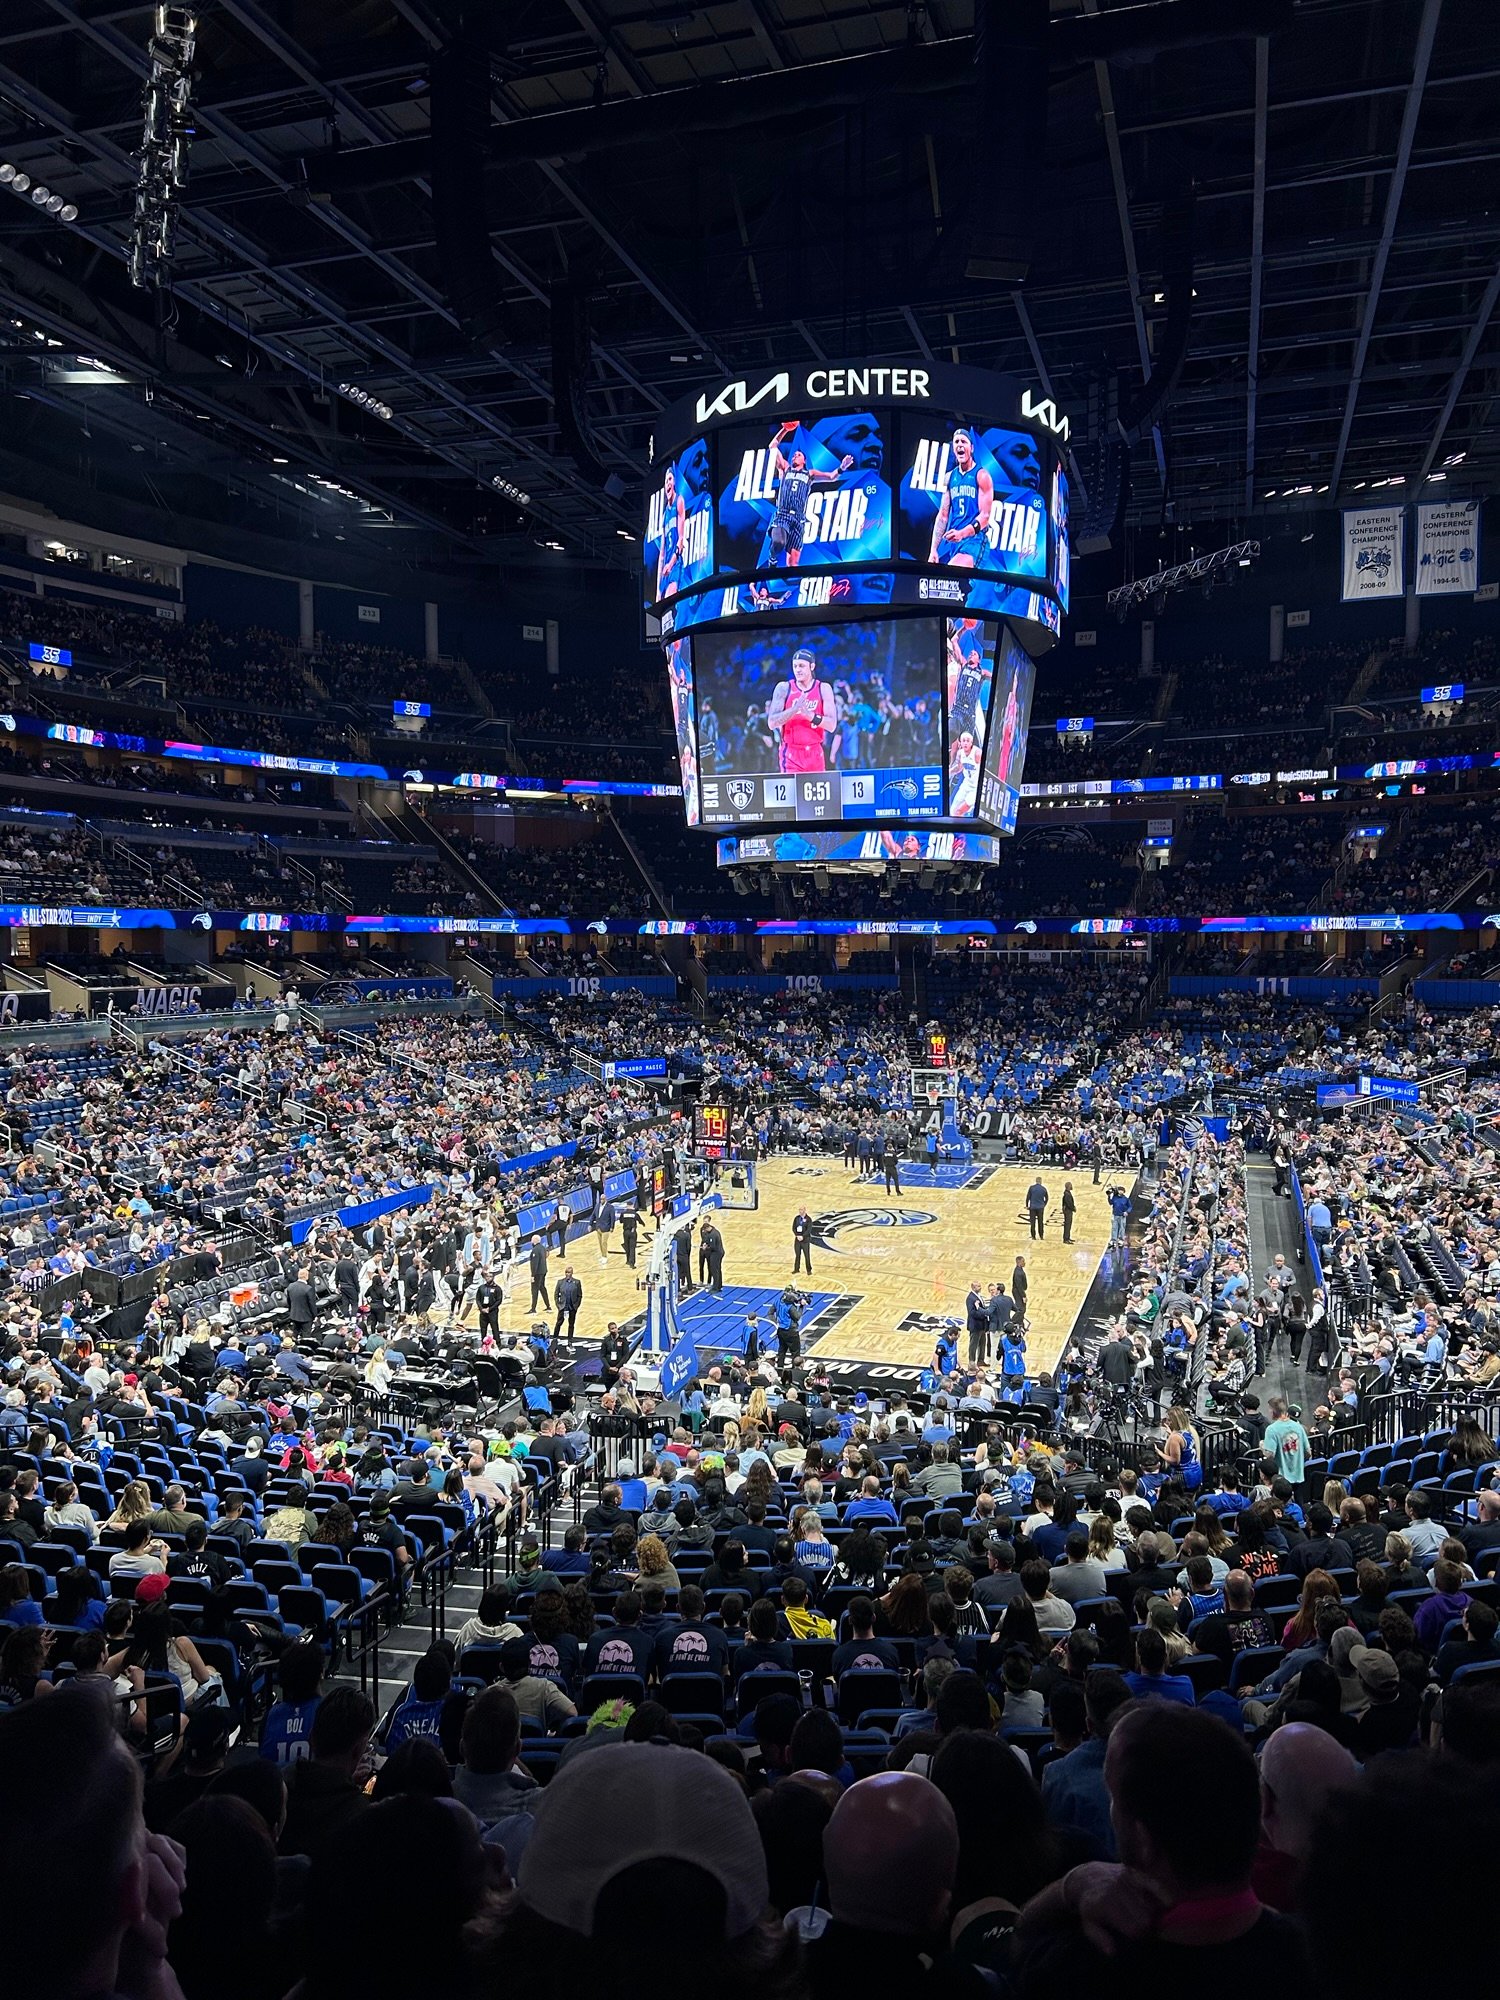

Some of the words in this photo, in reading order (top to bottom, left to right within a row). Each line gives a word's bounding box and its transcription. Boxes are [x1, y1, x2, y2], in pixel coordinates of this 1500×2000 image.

[806, 368, 930, 398] CENTER
[910, 438, 950, 493] ALL
[734, 448, 778, 501] ALL
[791, 480, 799, 492] 5
[958, 498, 966, 517] 5
[803, 488, 869, 545] STAR
[1356, 517, 1391, 526] EASTERN
[1431, 511, 1466, 520] EASTERN
[988, 499, 1042, 554] STAR
[1349, 525, 1399, 535] CONFERENCE
[1423, 520, 1473, 530] CONFERENCE
[1352, 534, 1396, 544] CHAMPIONS
[1425, 529, 1470, 539] CHAMPIONS
[1360, 582, 1386, 590] 2008-09
[1433, 577, 1460, 585] 1994-95
[797, 576, 833, 606] STAR
[1478, 587, 1494, 596] 219
[720, 586, 739, 617] ALL
[363, 608, 376, 618] 213
[527, 629, 540, 637] 214
[42, 646, 60, 665] 35
[966, 677, 973, 687] 5
[1433, 686, 1453, 701] 35
[404, 702, 420, 715] 35
[1067, 718, 1084, 731] 35
[1210, 777, 1217, 787] 6
[1276, 769, 1329, 783] Magic5050.com
[728, 781, 753, 795] NETS
[923, 774, 940, 800] ORL
[1048, 783, 1063, 795] 6:51
[1068, 783, 1078, 793] 1ST
[1095, 782, 1103, 792] 13
[1185, 778, 1191, 788] 2
[702, 783, 720, 808] BKN
[774, 784, 787, 801] 12
[803, 781, 831, 802] 6:51
[852, 781, 864, 799] 13
[1023, 785, 1031, 795] 12
[738, 794, 744, 805] B
[814, 805, 825, 816] 1ST
[860, 832, 884, 858] ALL
[926, 832, 954, 859] STAR
[29, 908, 59, 925] ALL-STAR
[58, 908, 73, 925] 2024
[86, 914, 103, 923] INDY
[1370, 919, 1386, 927] INDY
[443, 919, 467, 932] ALL-STAR
[862, 922, 887, 933] ALL-STAR
[1317, 917, 1344, 930] ALL-STAR
[1344, 918, 1358, 930] 2024
[567, 977, 600, 997] 108
[1256, 977, 1291, 997] 111
[136, 986, 202, 1015] MAGIC
[933, 1044, 945, 1054] 19
[618, 1065, 642, 1074] ORLANDO
[1372, 1083, 1395, 1094] ORLANDO
[705, 1118, 723, 1138] 19
[1013, 1353, 1018, 1366] 1
[362, 1531, 380, 1544] SUGGS
[186, 1563, 207, 1575] FULTZ
[686, 1653, 694, 1662] DE
[612, 1664, 619, 1672] DE
[286, 1717, 303, 1734] BOL
